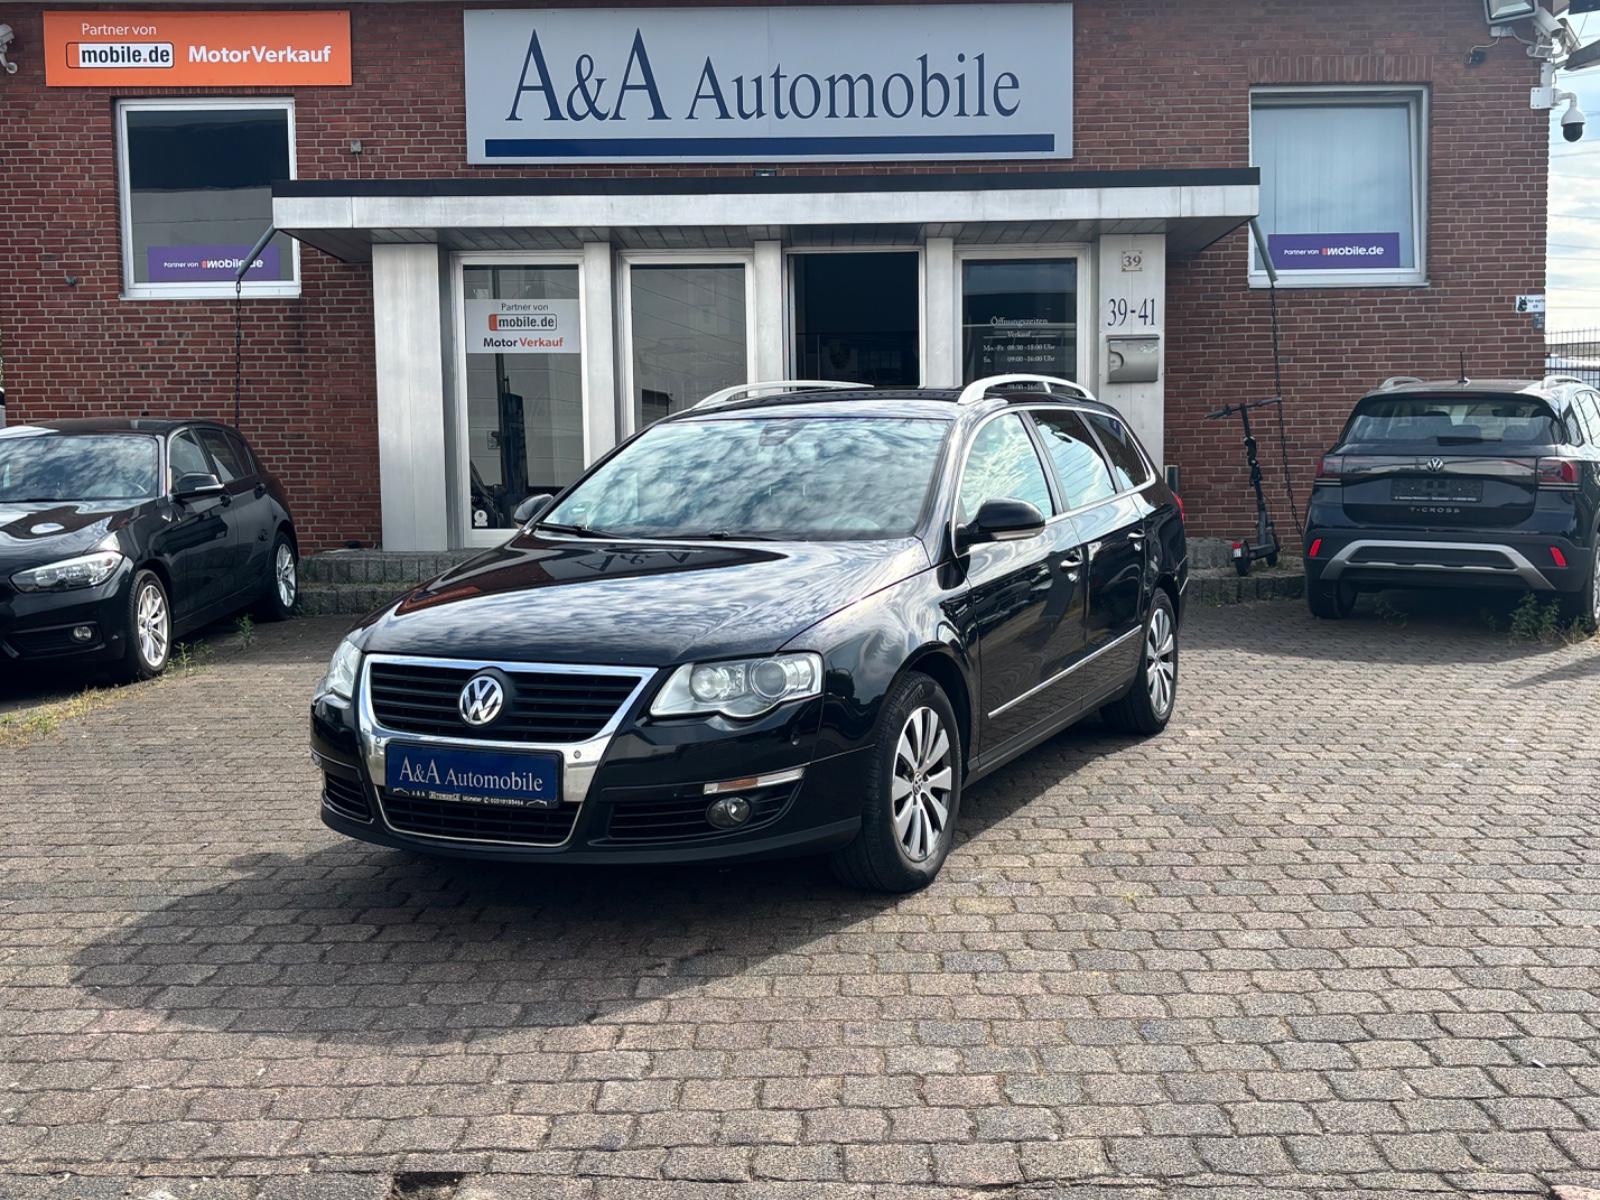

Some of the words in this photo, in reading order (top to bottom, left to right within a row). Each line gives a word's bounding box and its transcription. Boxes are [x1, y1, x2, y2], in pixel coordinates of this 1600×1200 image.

[81, 23, 130, 35] Partner
[131, 25, 157, 35] von
[81, 46, 170, 63] mobile.de
[505, 27, 672, 121] A&A
[684, 52, 1021, 120] Automobile
[1327, 246, 1384, 256] mobile.de
[1123, 255, 1141, 267] 39
[501, 303, 531, 311] Partner
[498, 316, 555, 328] mobile.de
[400, 756, 441, 785] A&A
[444, 767, 543, 793] Automobile
